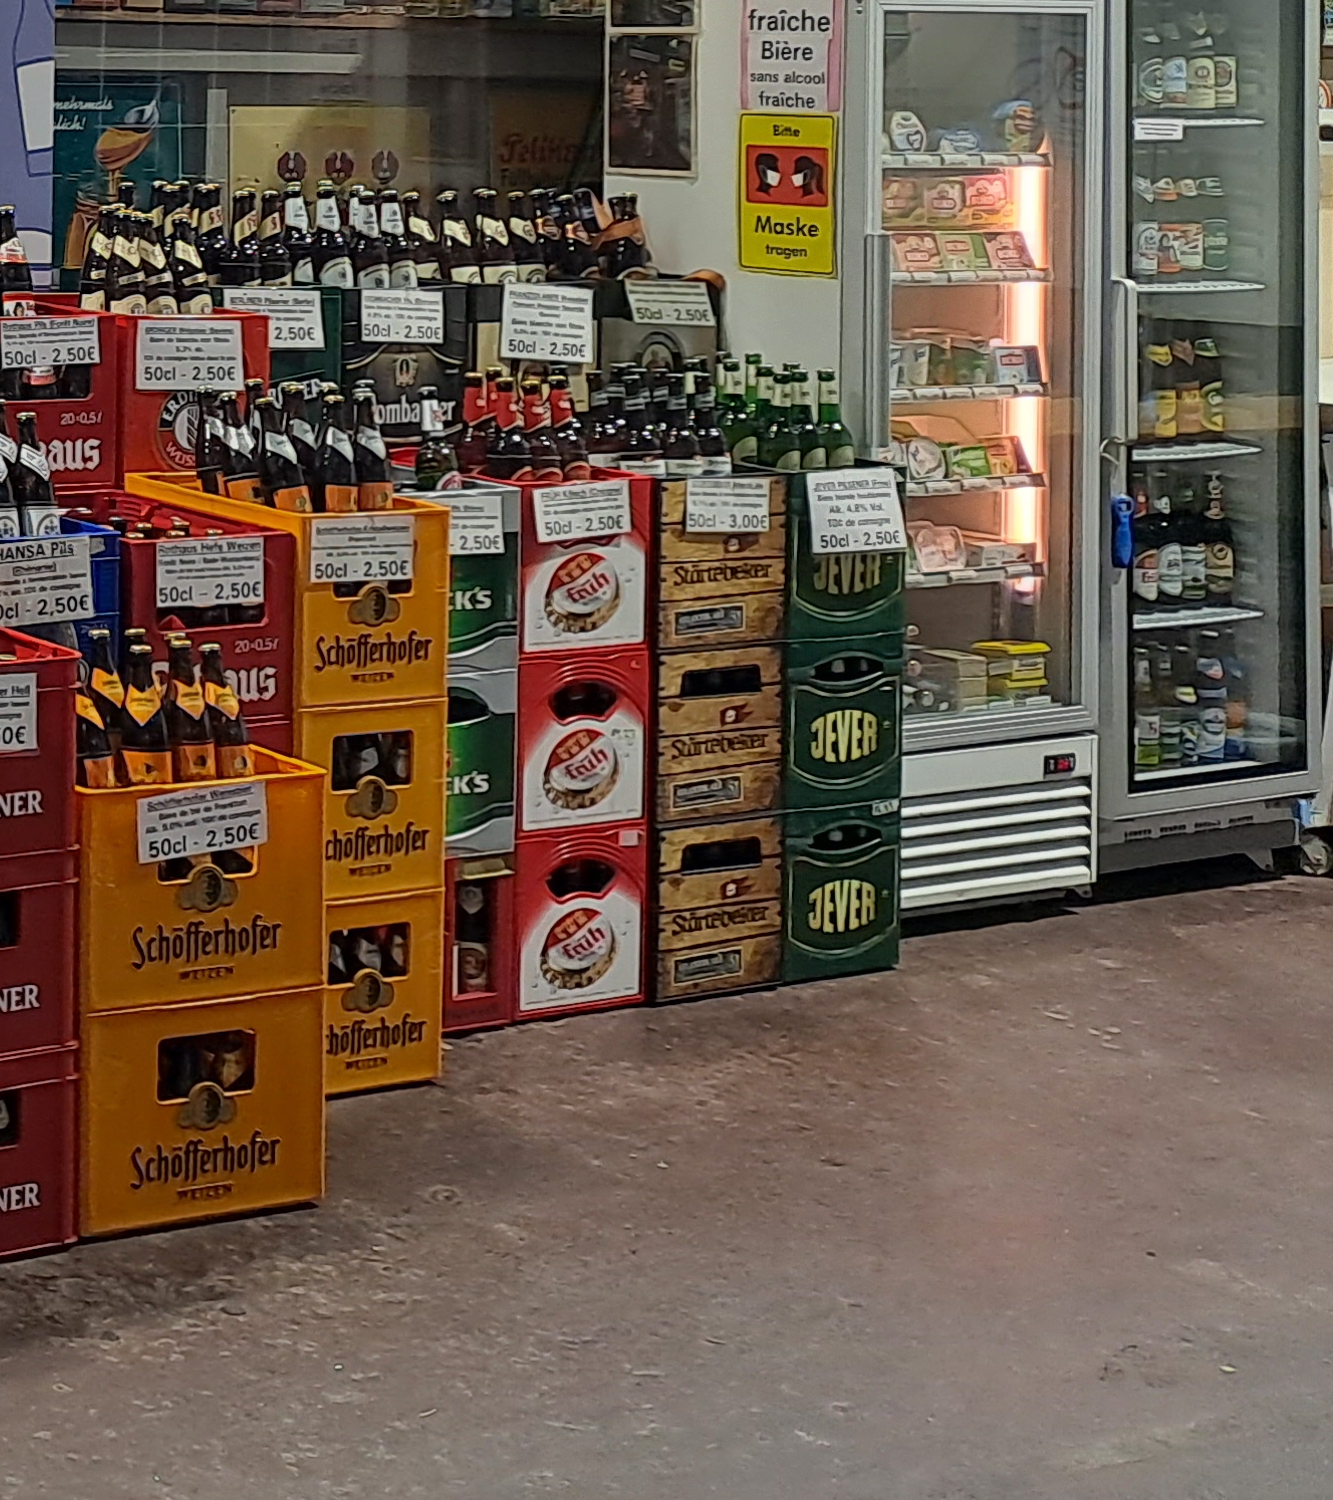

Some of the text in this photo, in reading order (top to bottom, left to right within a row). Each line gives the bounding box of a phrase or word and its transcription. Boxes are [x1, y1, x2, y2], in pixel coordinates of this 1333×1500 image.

[748, 8, 831, 33] fraîche
[761, 38, 814, 61] Bière
[750, 71, 826, 84] sans alcool
[758, 93, 816, 109] fraîche
[772, 124, 801, 138] Bitte
[754, 215, 821, 238] Maske
[765, 244, 808, 258] tragen
[636, 307, 663, 321] 50cl
[274, 326, 316, 341] 2,50€
[363, 324, 391, 338] 50cl
[4, 346, 96, 367] 50cl 2,50€
[508, 340, 537, 355] 50cl
[144, 366, 177, 382] 50cl
[543, 519, 573, 537] 50cl
[687, 513, 768, 530] 50cl 3,00€
[458, 535, 501, 551] 2,50€
[819, 530, 900, 549] 50cl 2,50€
[50, 541, 75, 561] Pils
[314, 559, 409, 581] 50cl 2,50€
[813, 554, 882, 595] JEVER
[158, 581, 262, 603] 50cl 2,50€
[37, 594, 90, 617] 2,50€
[314, 630, 433, 672] Schöfferhofer
[810, 709, 879, 763] JEVER
[564, 748, 610, 781] früh
[148, 822, 260, 858] 50cl 2,50€
[325, 821, 430, 862] chöfferhofer
[808, 879, 877, 934] JEVER
[132, 913, 283, 970] Schöfferhofer
[130, 1129, 282, 1191] Schöfferhofer
